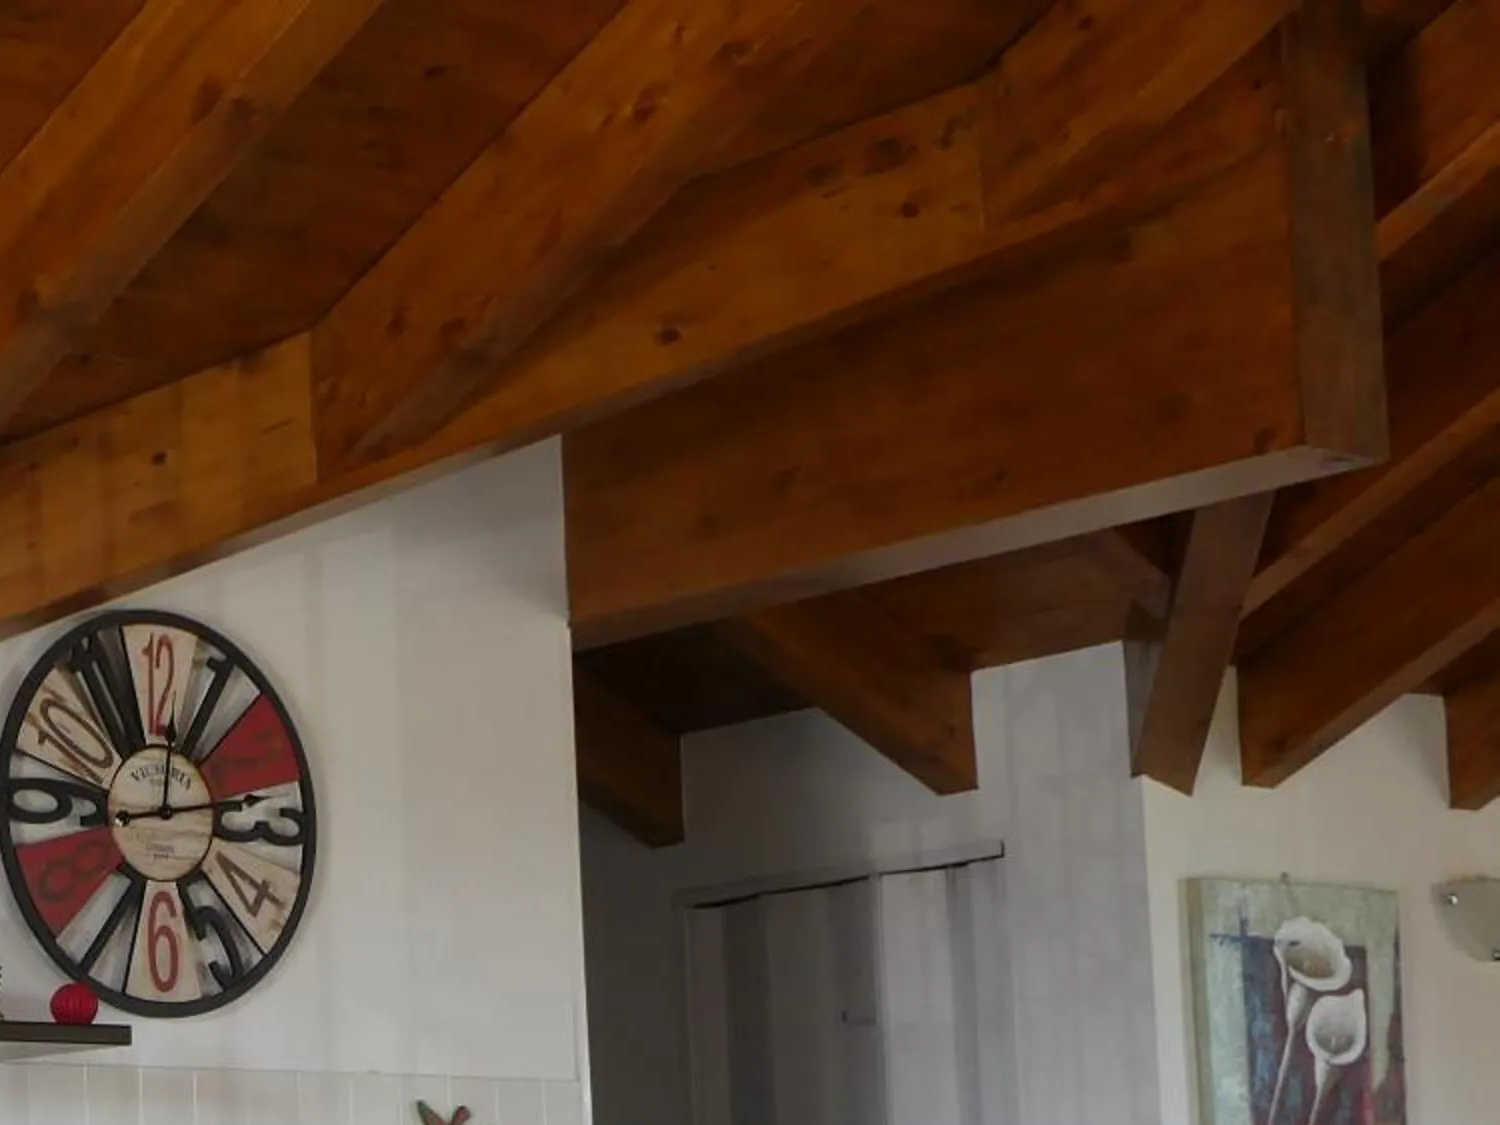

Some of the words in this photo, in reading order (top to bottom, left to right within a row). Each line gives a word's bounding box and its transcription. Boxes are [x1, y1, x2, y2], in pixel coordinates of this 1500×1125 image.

[141, 633, 177, 737] 12
[178, 655, 235, 753] 1
[37, 690, 115, 787] 10
[130, 764, 192, 791] VICTRIA
[6, 778, 108, 827] 9
[212, 798, 304, 846] 3
[215, 849, 285, 918] 4
[147, 890, 180, 993] 6
[178, 880, 245, 990] 5
